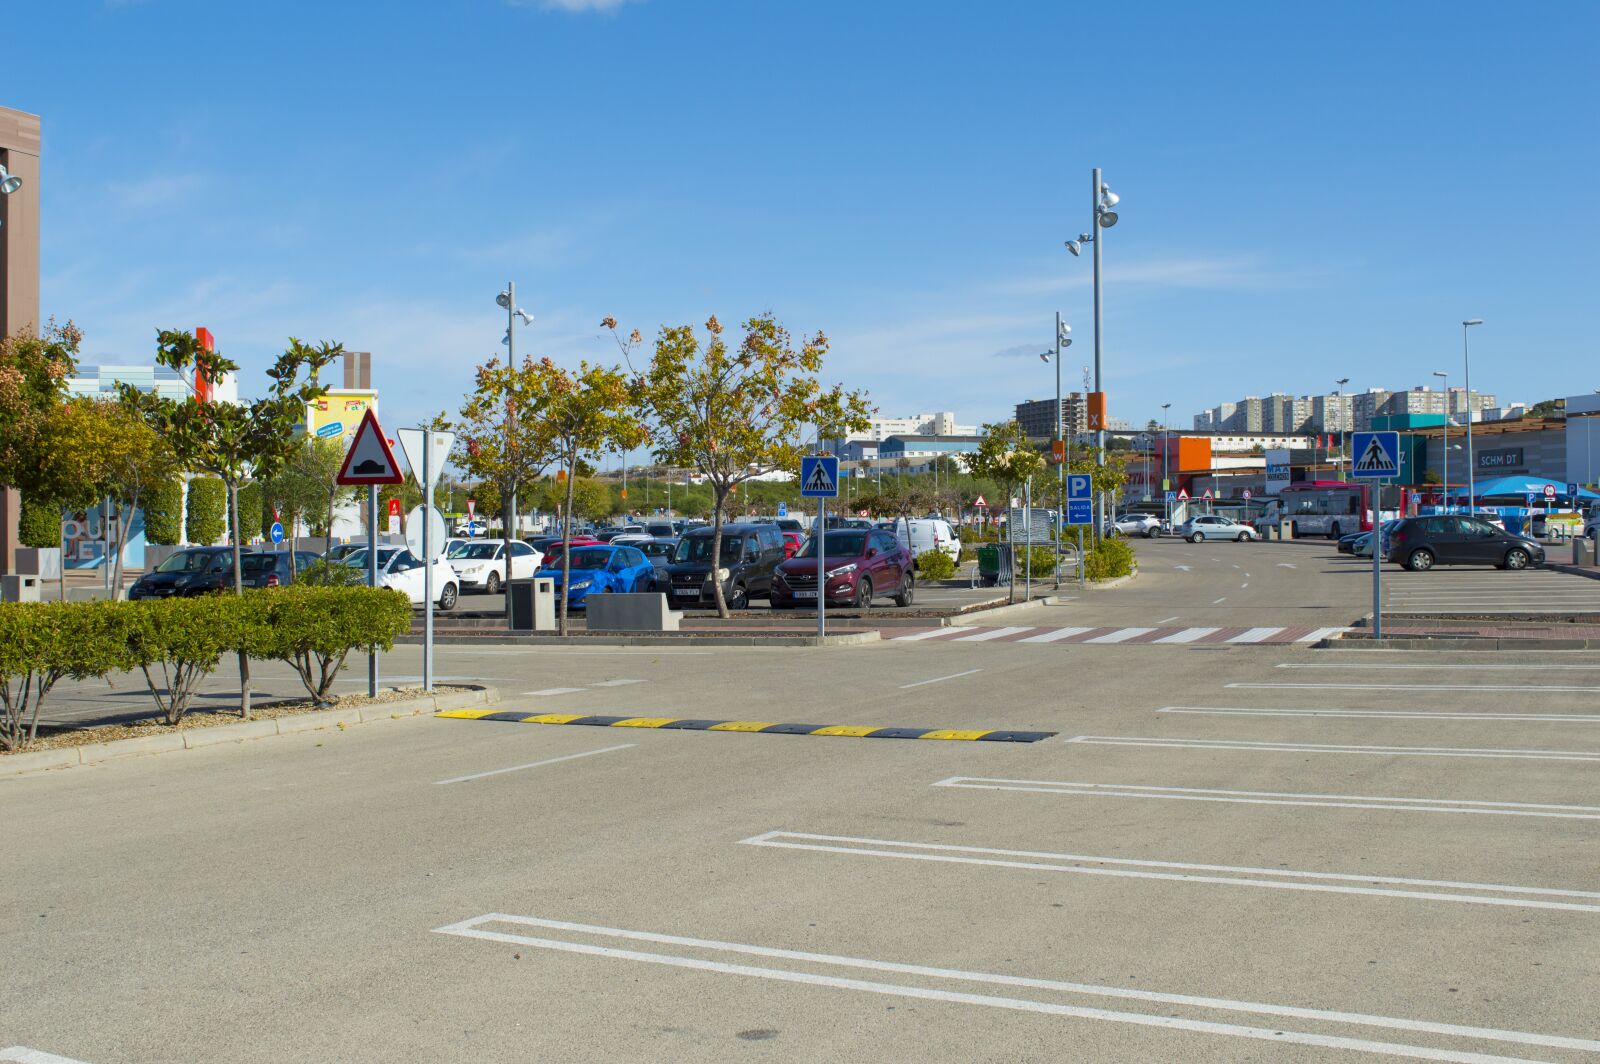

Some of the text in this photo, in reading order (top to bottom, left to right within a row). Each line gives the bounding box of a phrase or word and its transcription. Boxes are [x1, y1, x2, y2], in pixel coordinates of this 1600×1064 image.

[1091, 414, 1098, 426] X
[1053, 453, 1062, 461] W
[1072, 478, 1087, 497] P
[1569, 485, 1576, 495] P
